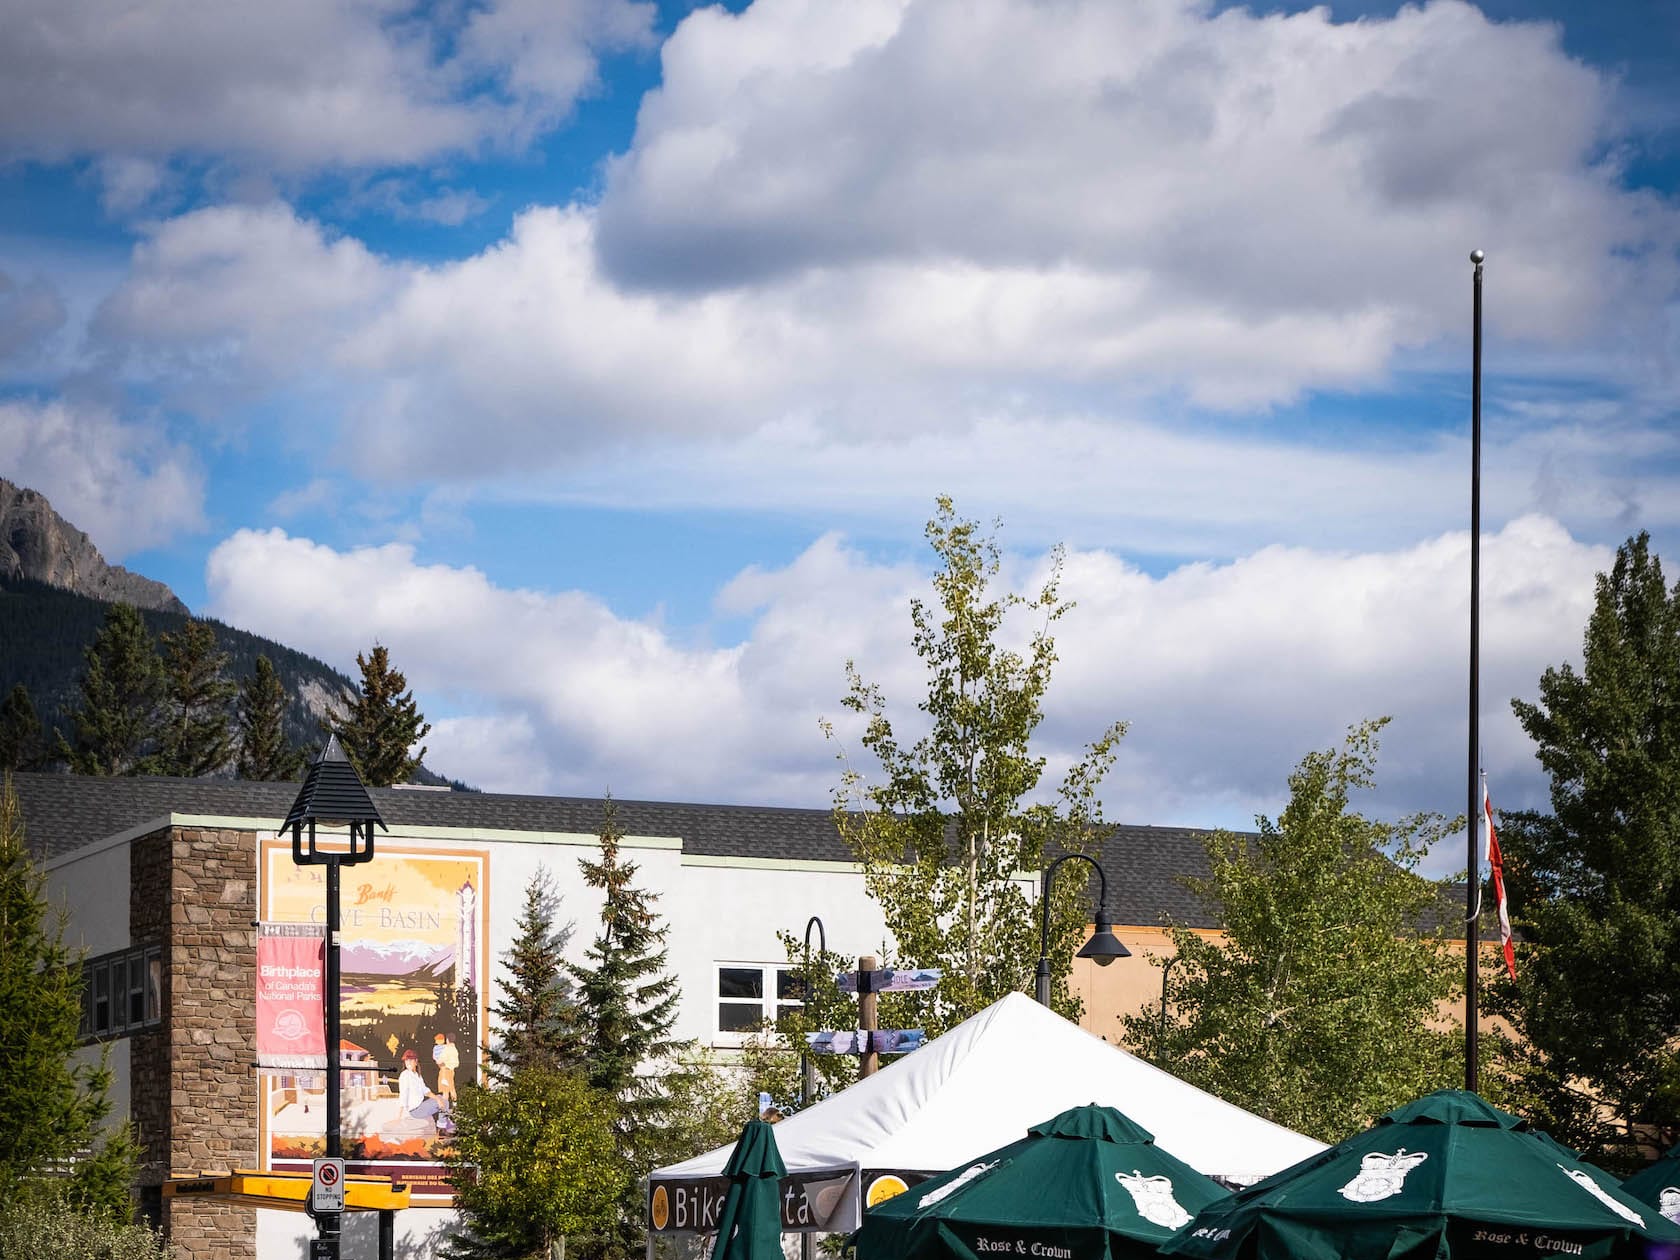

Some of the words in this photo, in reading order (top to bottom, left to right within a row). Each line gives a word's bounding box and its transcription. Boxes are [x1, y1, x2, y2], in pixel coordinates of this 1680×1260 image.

[354, 883, 398, 905] Banff
[310, 905, 363, 926] CVE
[379, 907, 440, 929] BASIN
[260, 965, 321, 979] Birthplace
[259, 992, 295, 1000] National
[297, 992, 321, 1000] Parks
[265, 981, 274, 990] of
[275, 981, 316, 991] Canada's
[977, 1237, 1012, 1252] Rose
[1015, 1240, 1027, 1254] &
[1031, 1242, 1072, 1259] Crown
[1472, 1231, 1511, 1244] Rose
[1515, 1233, 1528, 1245] &
[1534, 1235, 1582, 1255] Crown
